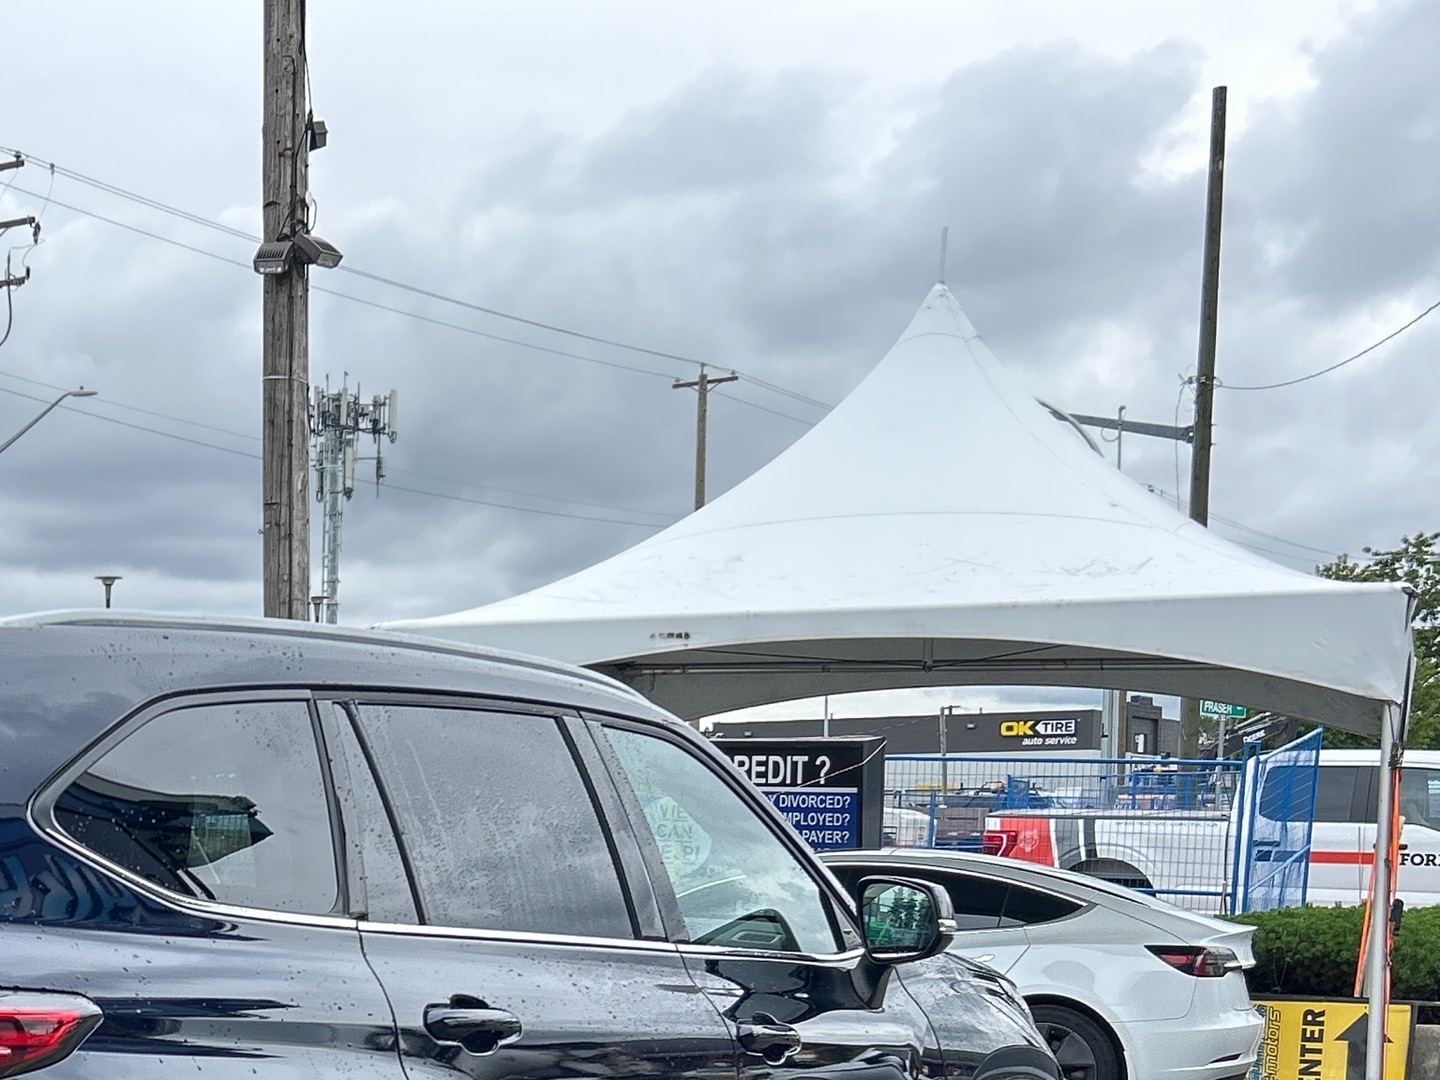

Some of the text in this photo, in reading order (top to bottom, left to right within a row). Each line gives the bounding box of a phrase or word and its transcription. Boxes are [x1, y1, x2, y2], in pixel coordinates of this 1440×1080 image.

[1203, 701, 1233, 714] FRASER
[1000, 720, 1074, 736] OK TIRE
[1022, 735, 1078, 745] auto service
[779, 794, 851, 809] DIVORCED?
[782, 812, 851, 827] MPLOYED?
[656, 823, 692, 839] CAN
[1399, 853, 1440, 867] FOR
[1264, 1006, 1281, 1075] motors
